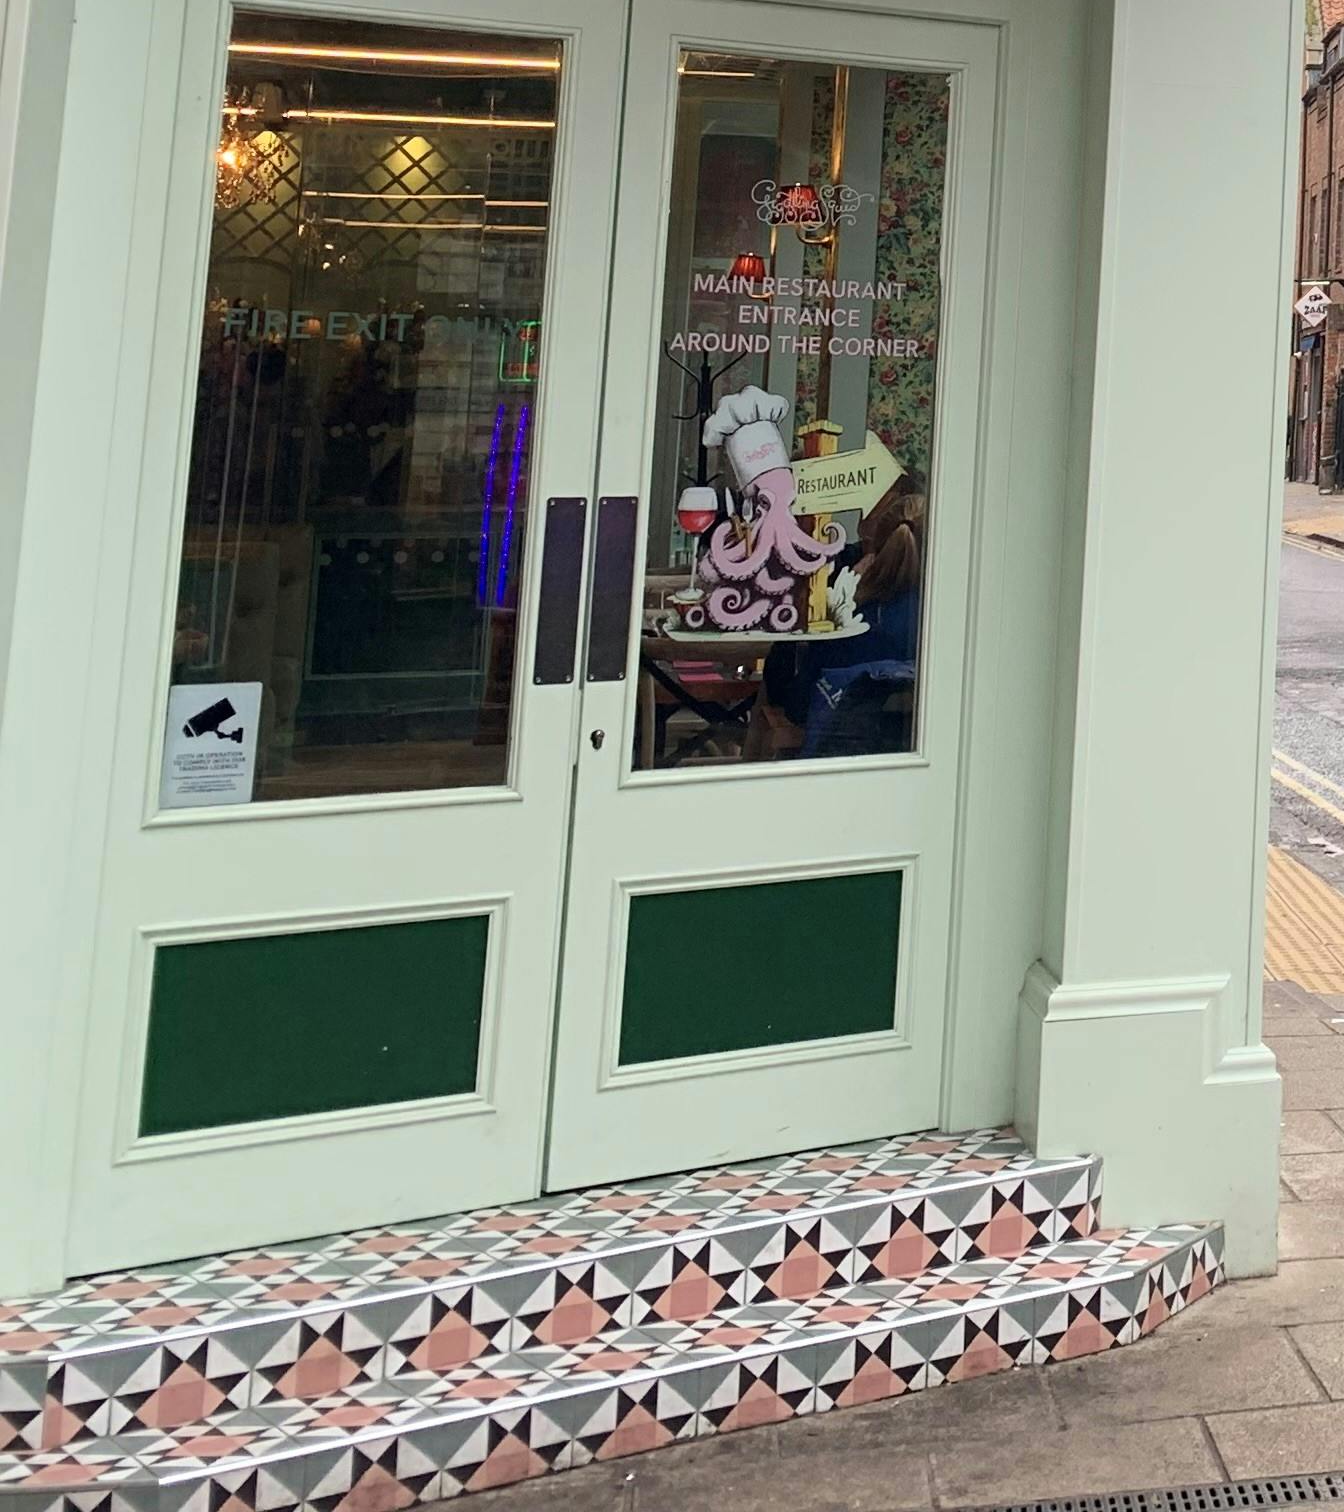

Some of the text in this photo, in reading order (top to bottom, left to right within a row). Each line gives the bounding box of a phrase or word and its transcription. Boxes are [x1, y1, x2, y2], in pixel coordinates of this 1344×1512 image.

[693, 273, 907, 302] MAIN RESTAURANT
[223, 307, 315, 339] FIRE
[324, 310, 415, 343] EXIT
[738, 304, 861, 328] ENTRANCE
[669, 331, 919, 358] AROUND THE CORNER
[797, 466, 877, 495] RESTAURANT
